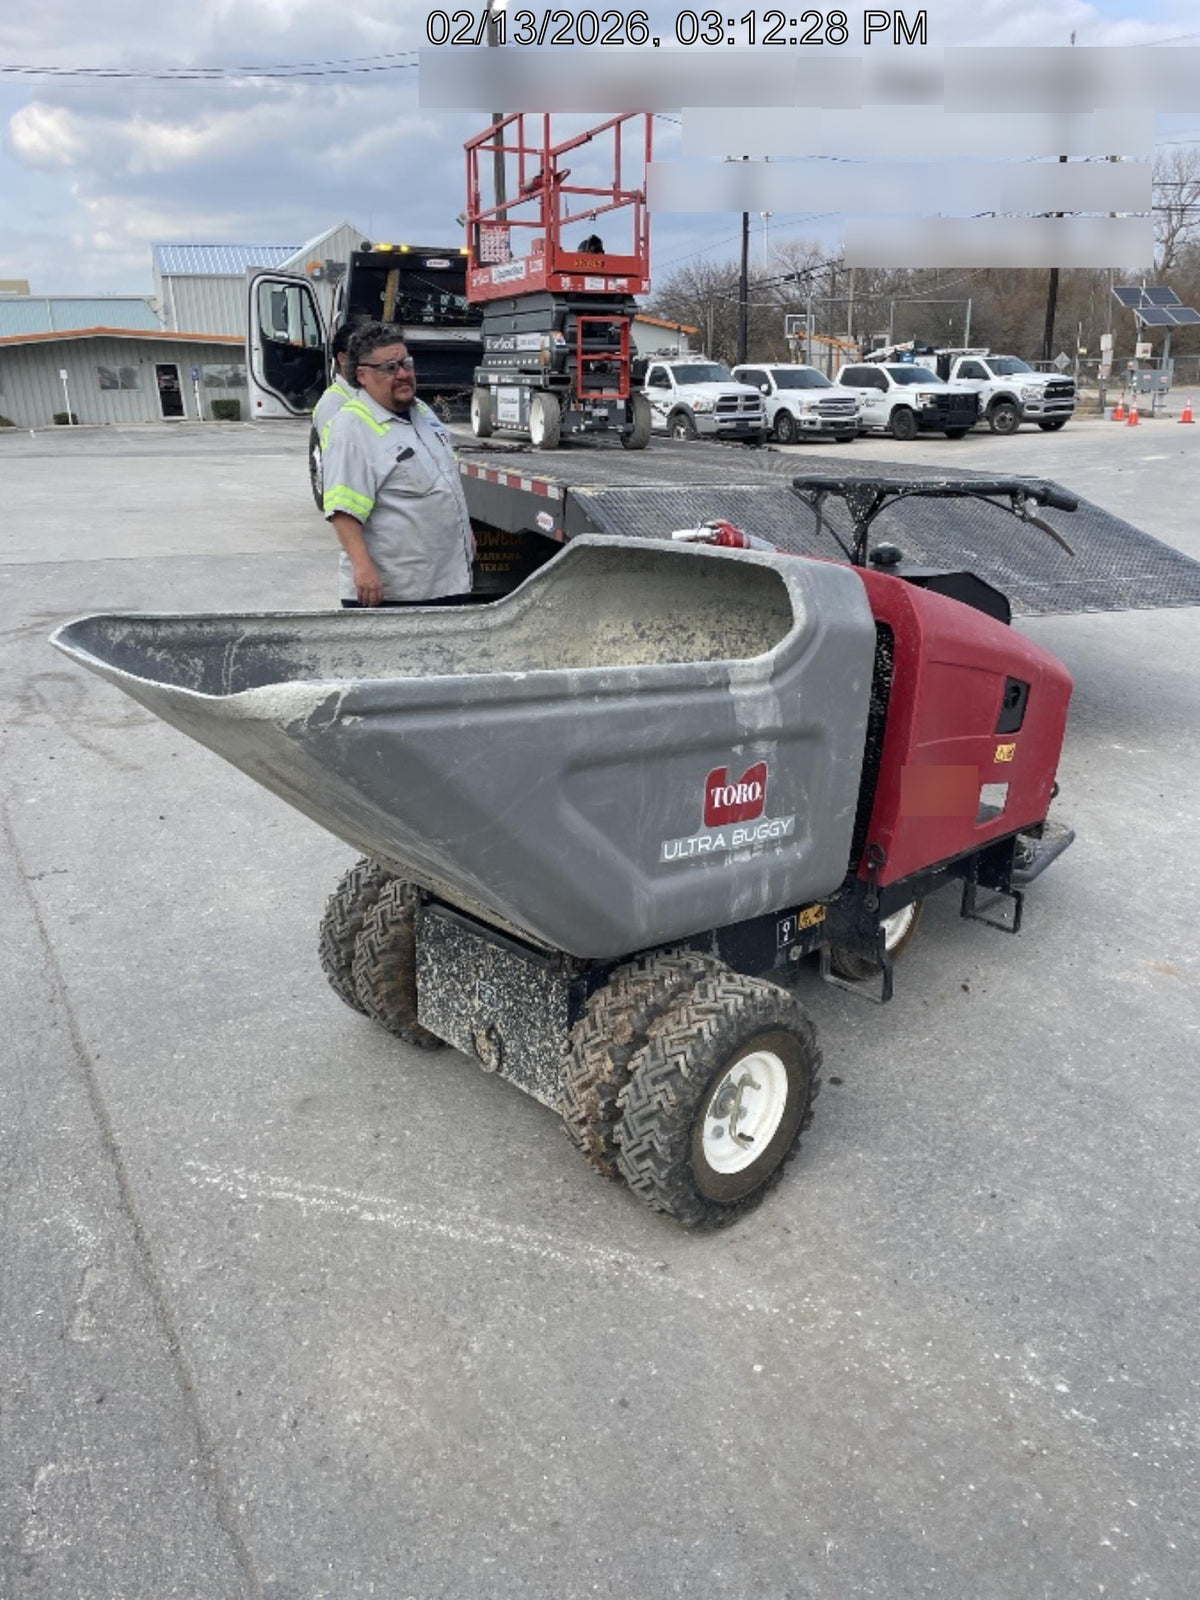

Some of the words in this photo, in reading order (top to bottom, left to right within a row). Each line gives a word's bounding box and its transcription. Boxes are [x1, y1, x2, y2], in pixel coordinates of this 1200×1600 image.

[711, 781, 762, 809] TORO
[664, 833, 726, 860] ULTRA
[732, 819, 792, 846] BUGGY
